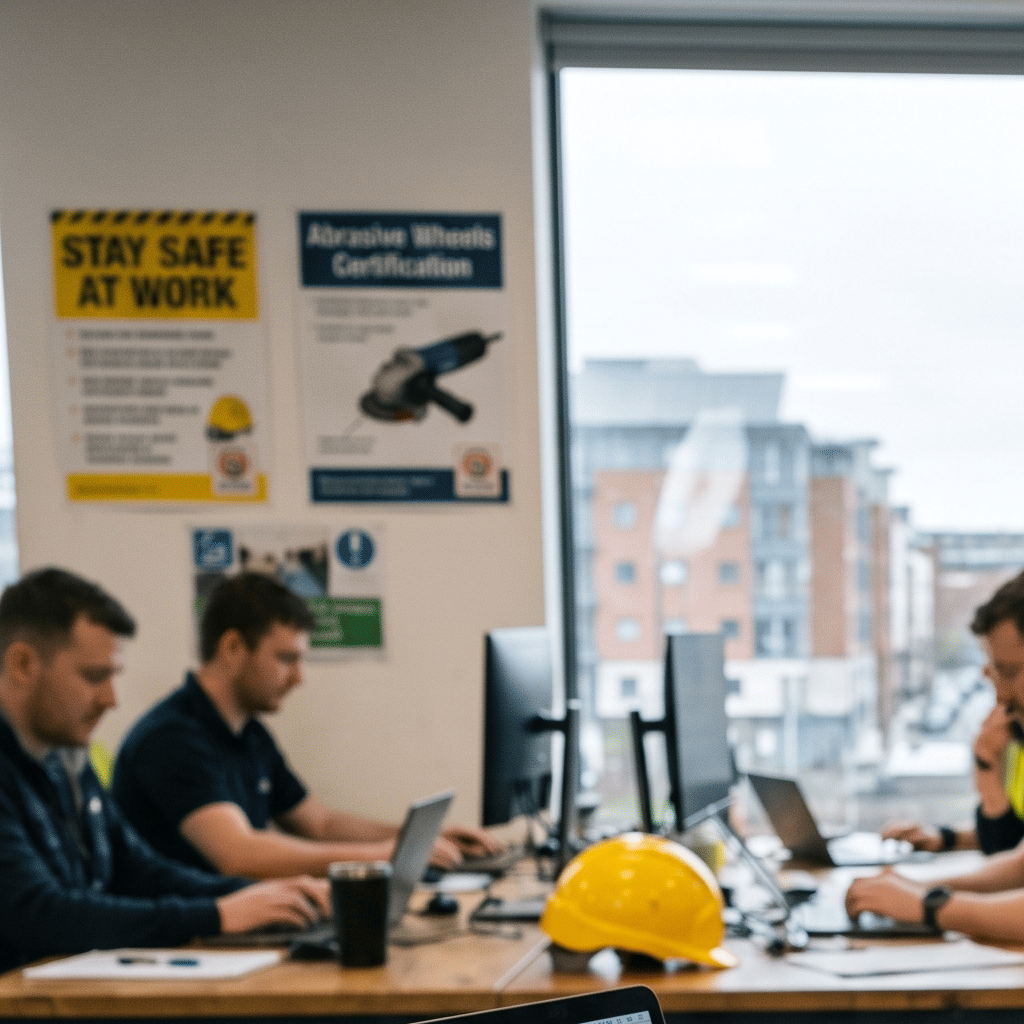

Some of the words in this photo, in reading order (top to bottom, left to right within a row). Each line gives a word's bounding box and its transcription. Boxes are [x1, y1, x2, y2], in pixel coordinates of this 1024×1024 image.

[307, 221, 404, 250] Abrasive
[411, 224, 496, 250] Wheels
[61, 235, 147, 270] STAY
[158, 234, 247, 269] SAFE
[332, 251, 473, 279] Certification
[78, 276, 121, 310] AT
[130, 275, 238, 309] WORK
